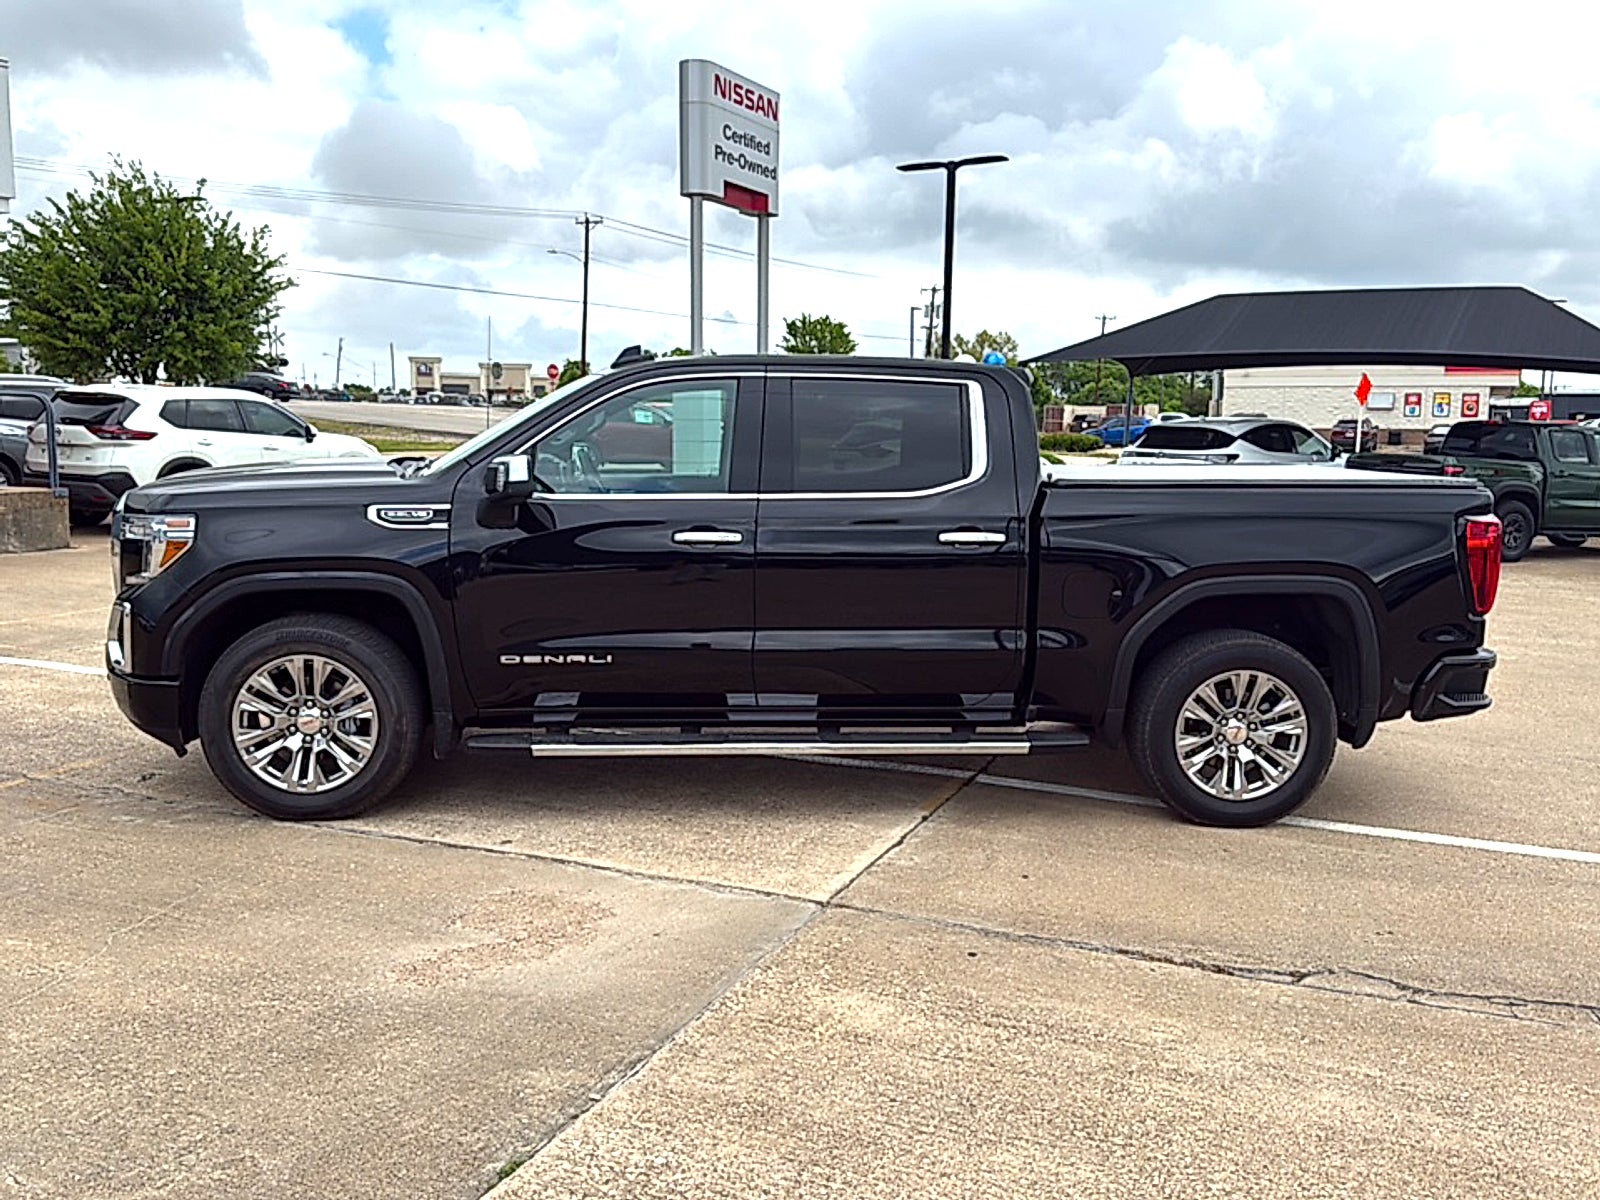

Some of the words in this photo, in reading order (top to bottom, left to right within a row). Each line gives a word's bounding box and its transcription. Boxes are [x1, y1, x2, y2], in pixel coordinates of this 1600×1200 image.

[714, 73, 778, 121] NISSAN
[723, 123, 771, 156] Certified
[714, 144, 777, 180] Pre-Owned
[499, 654, 613, 664] DENALI
